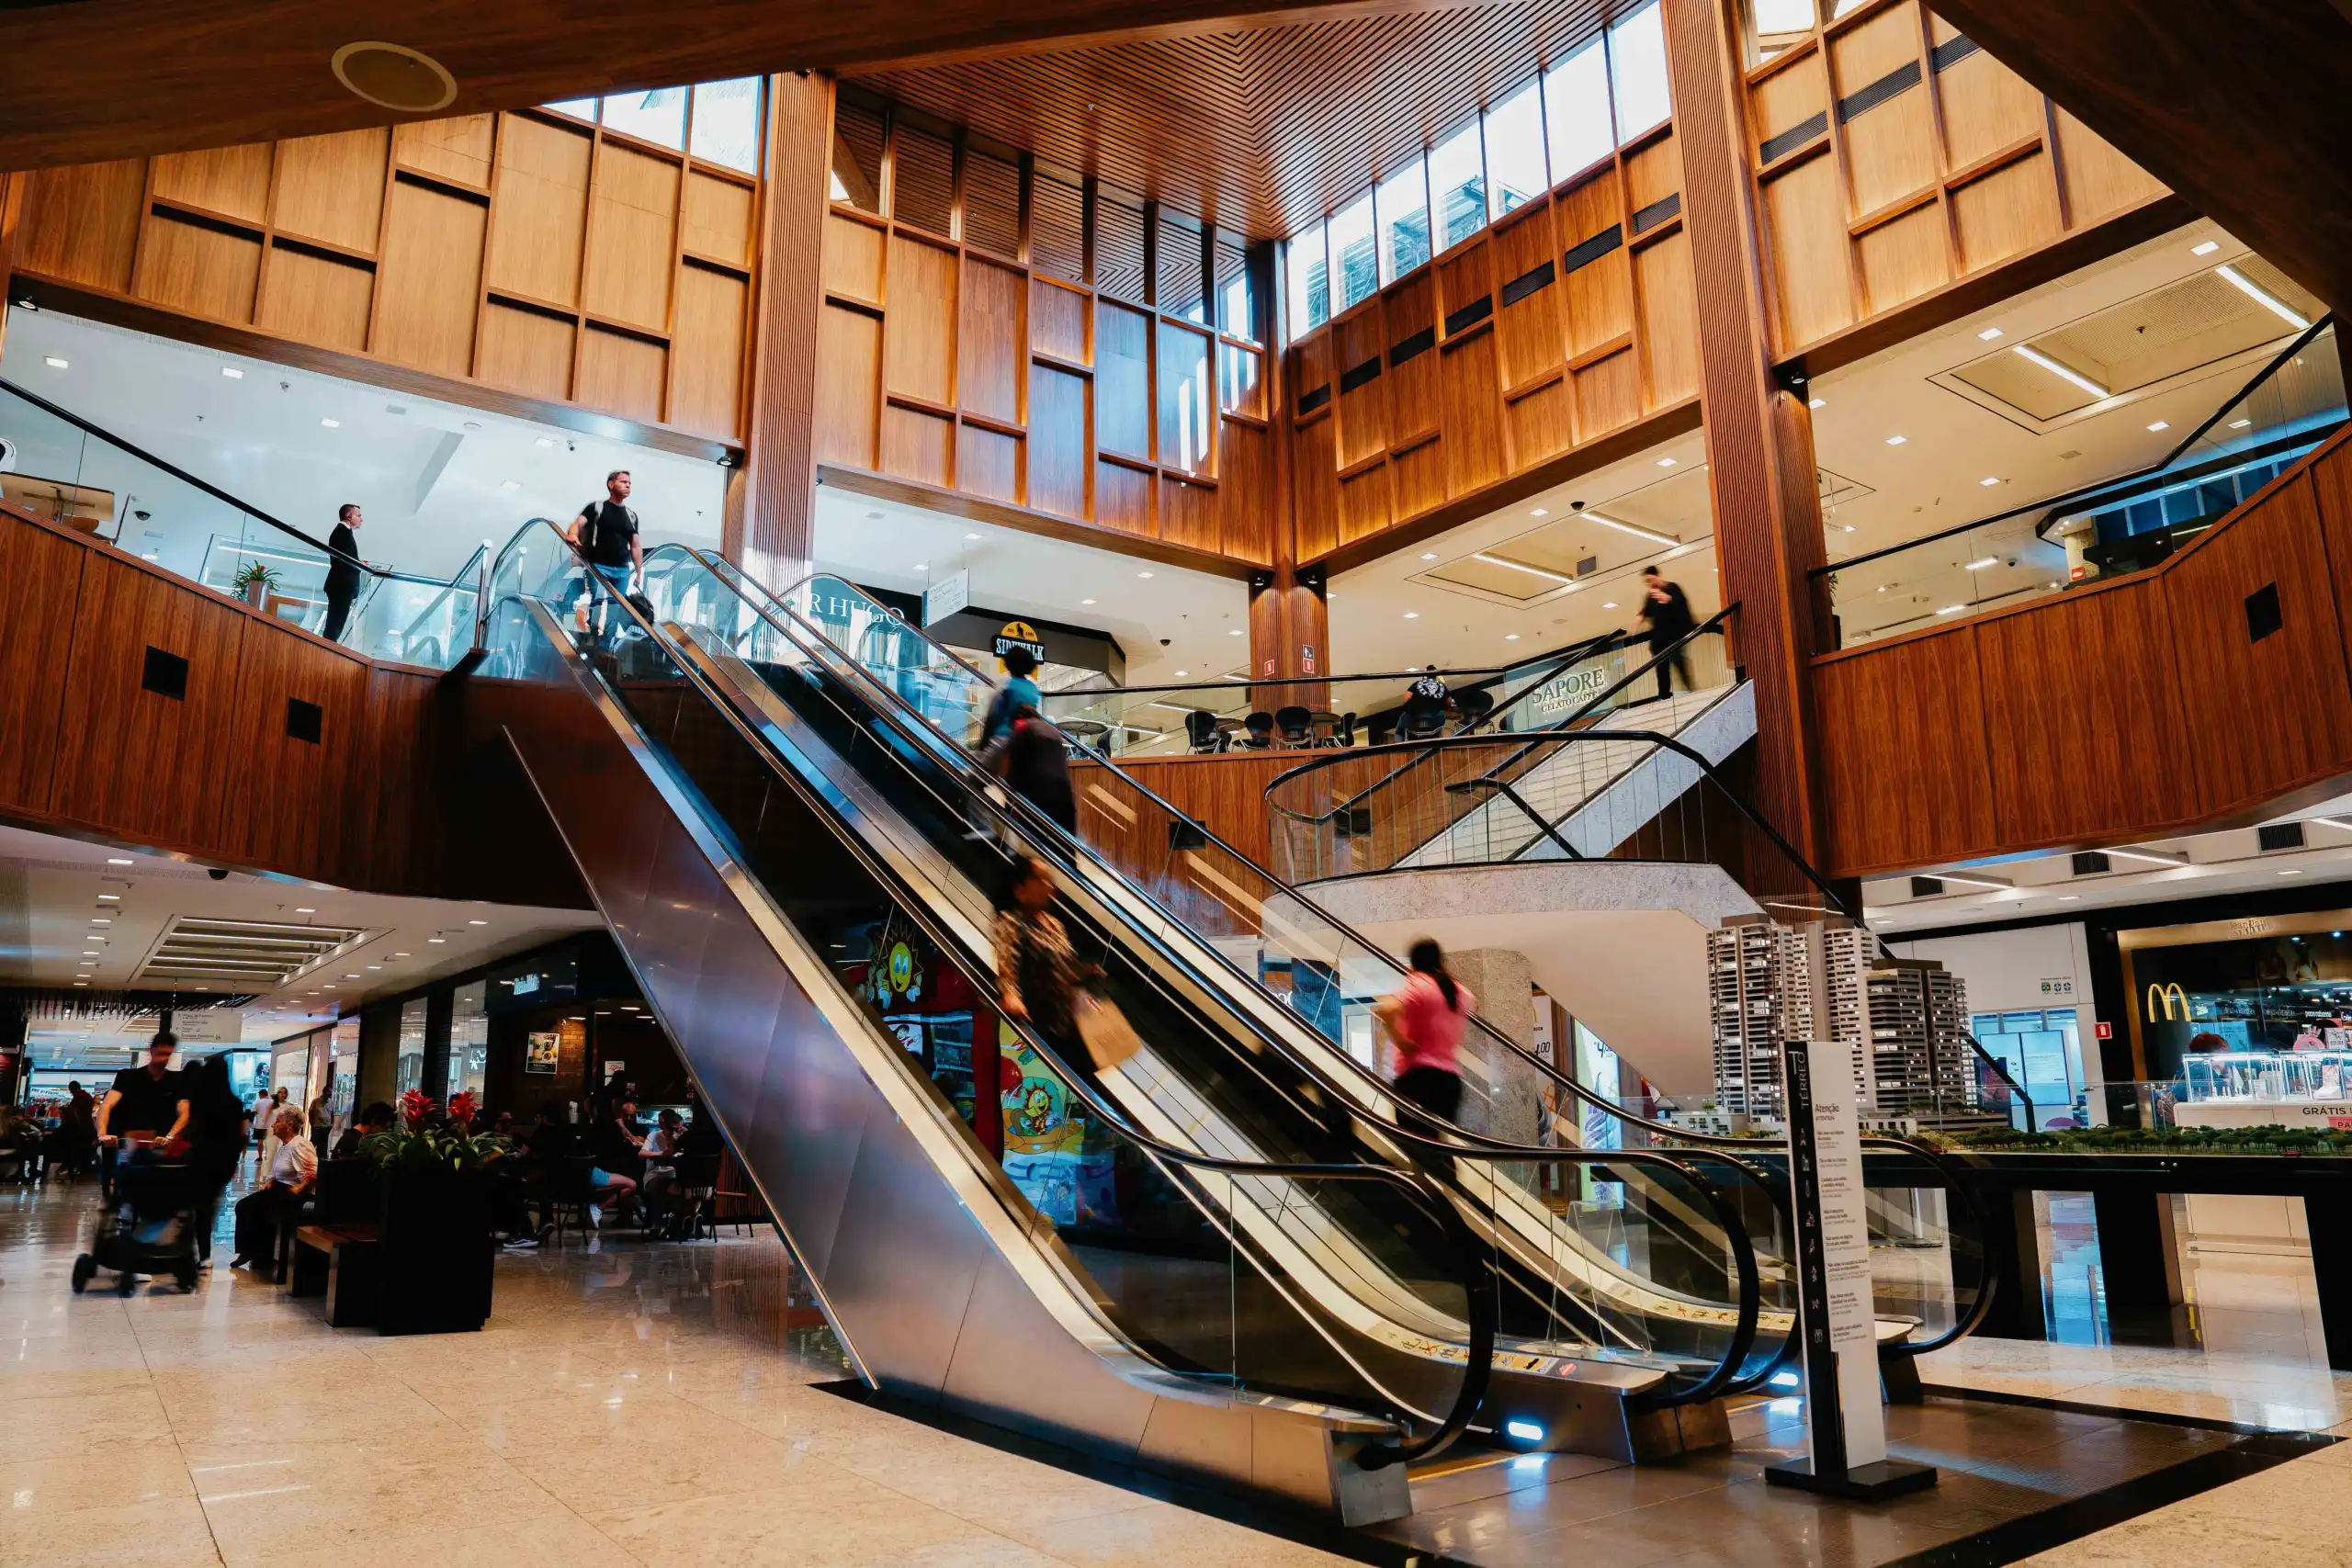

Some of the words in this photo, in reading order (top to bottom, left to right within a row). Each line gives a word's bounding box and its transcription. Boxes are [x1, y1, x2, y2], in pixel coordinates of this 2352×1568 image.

[1532, 669, 1604, 704] SAPORE
[1541, 699, 1572, 713] GELATO
[1815, 1103, 1839, 1114] Atenção
[2302, 1105, 2346, 1115] GRÁTIS
